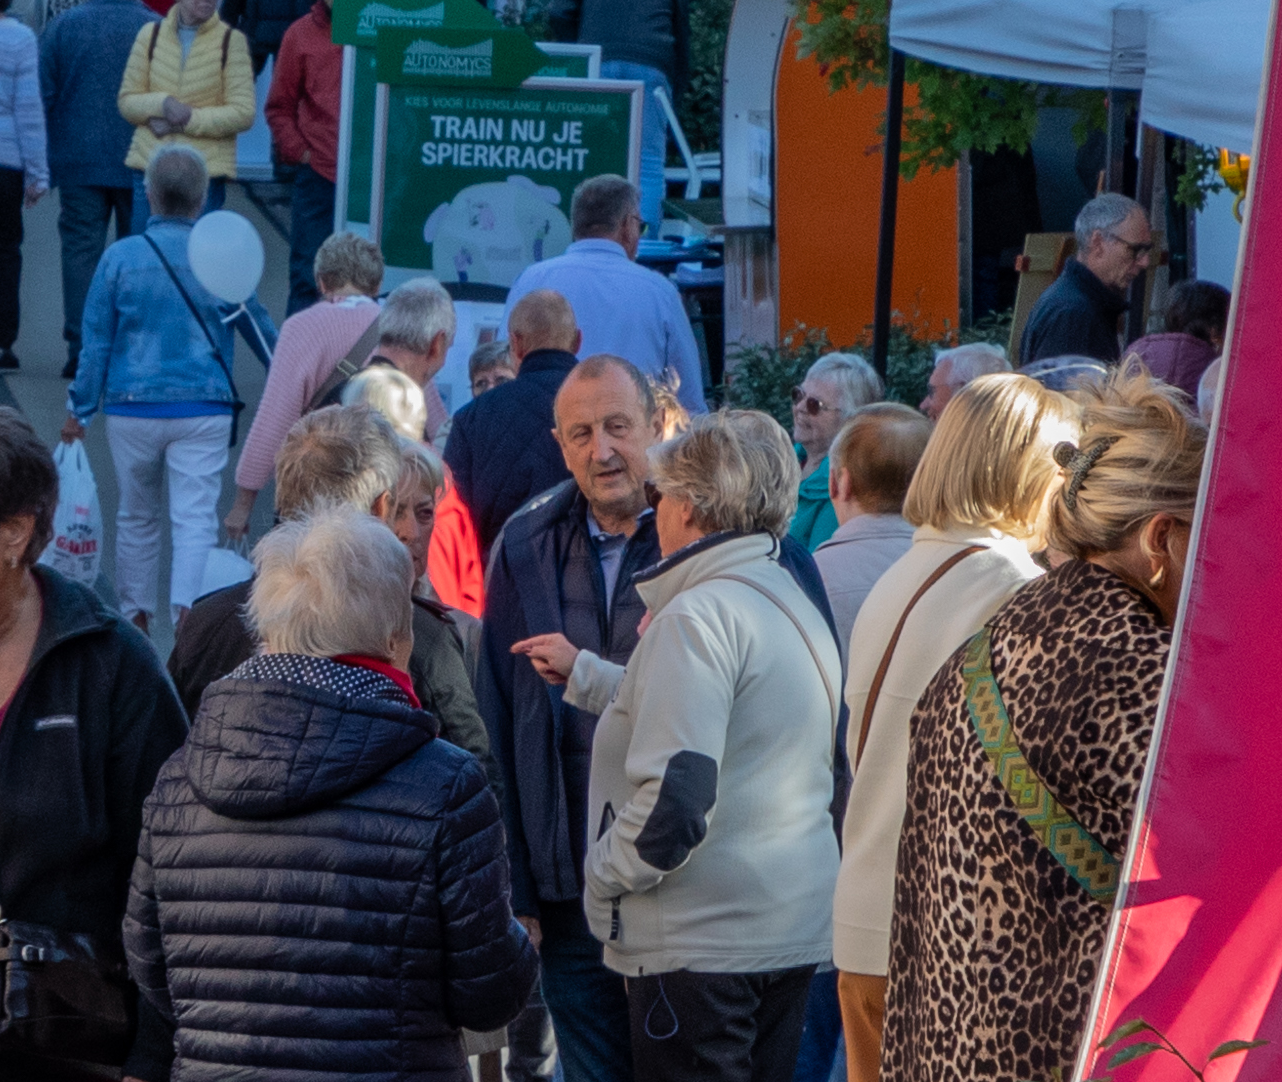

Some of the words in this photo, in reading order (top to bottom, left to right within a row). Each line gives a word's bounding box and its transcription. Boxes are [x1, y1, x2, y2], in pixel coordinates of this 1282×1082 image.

[403, 54, 492, 75] AUTONOMYCS
[433, 97, 464, 110] VOOR
[545, 101, 610, 116] AUTONOMIE
[431, 115, 504, 141] TRAIN
[511, 118, 546, 143] NU
[553, 121, 583, 145] JE
[421, 141, 589, 171] SPIERKRACHT
